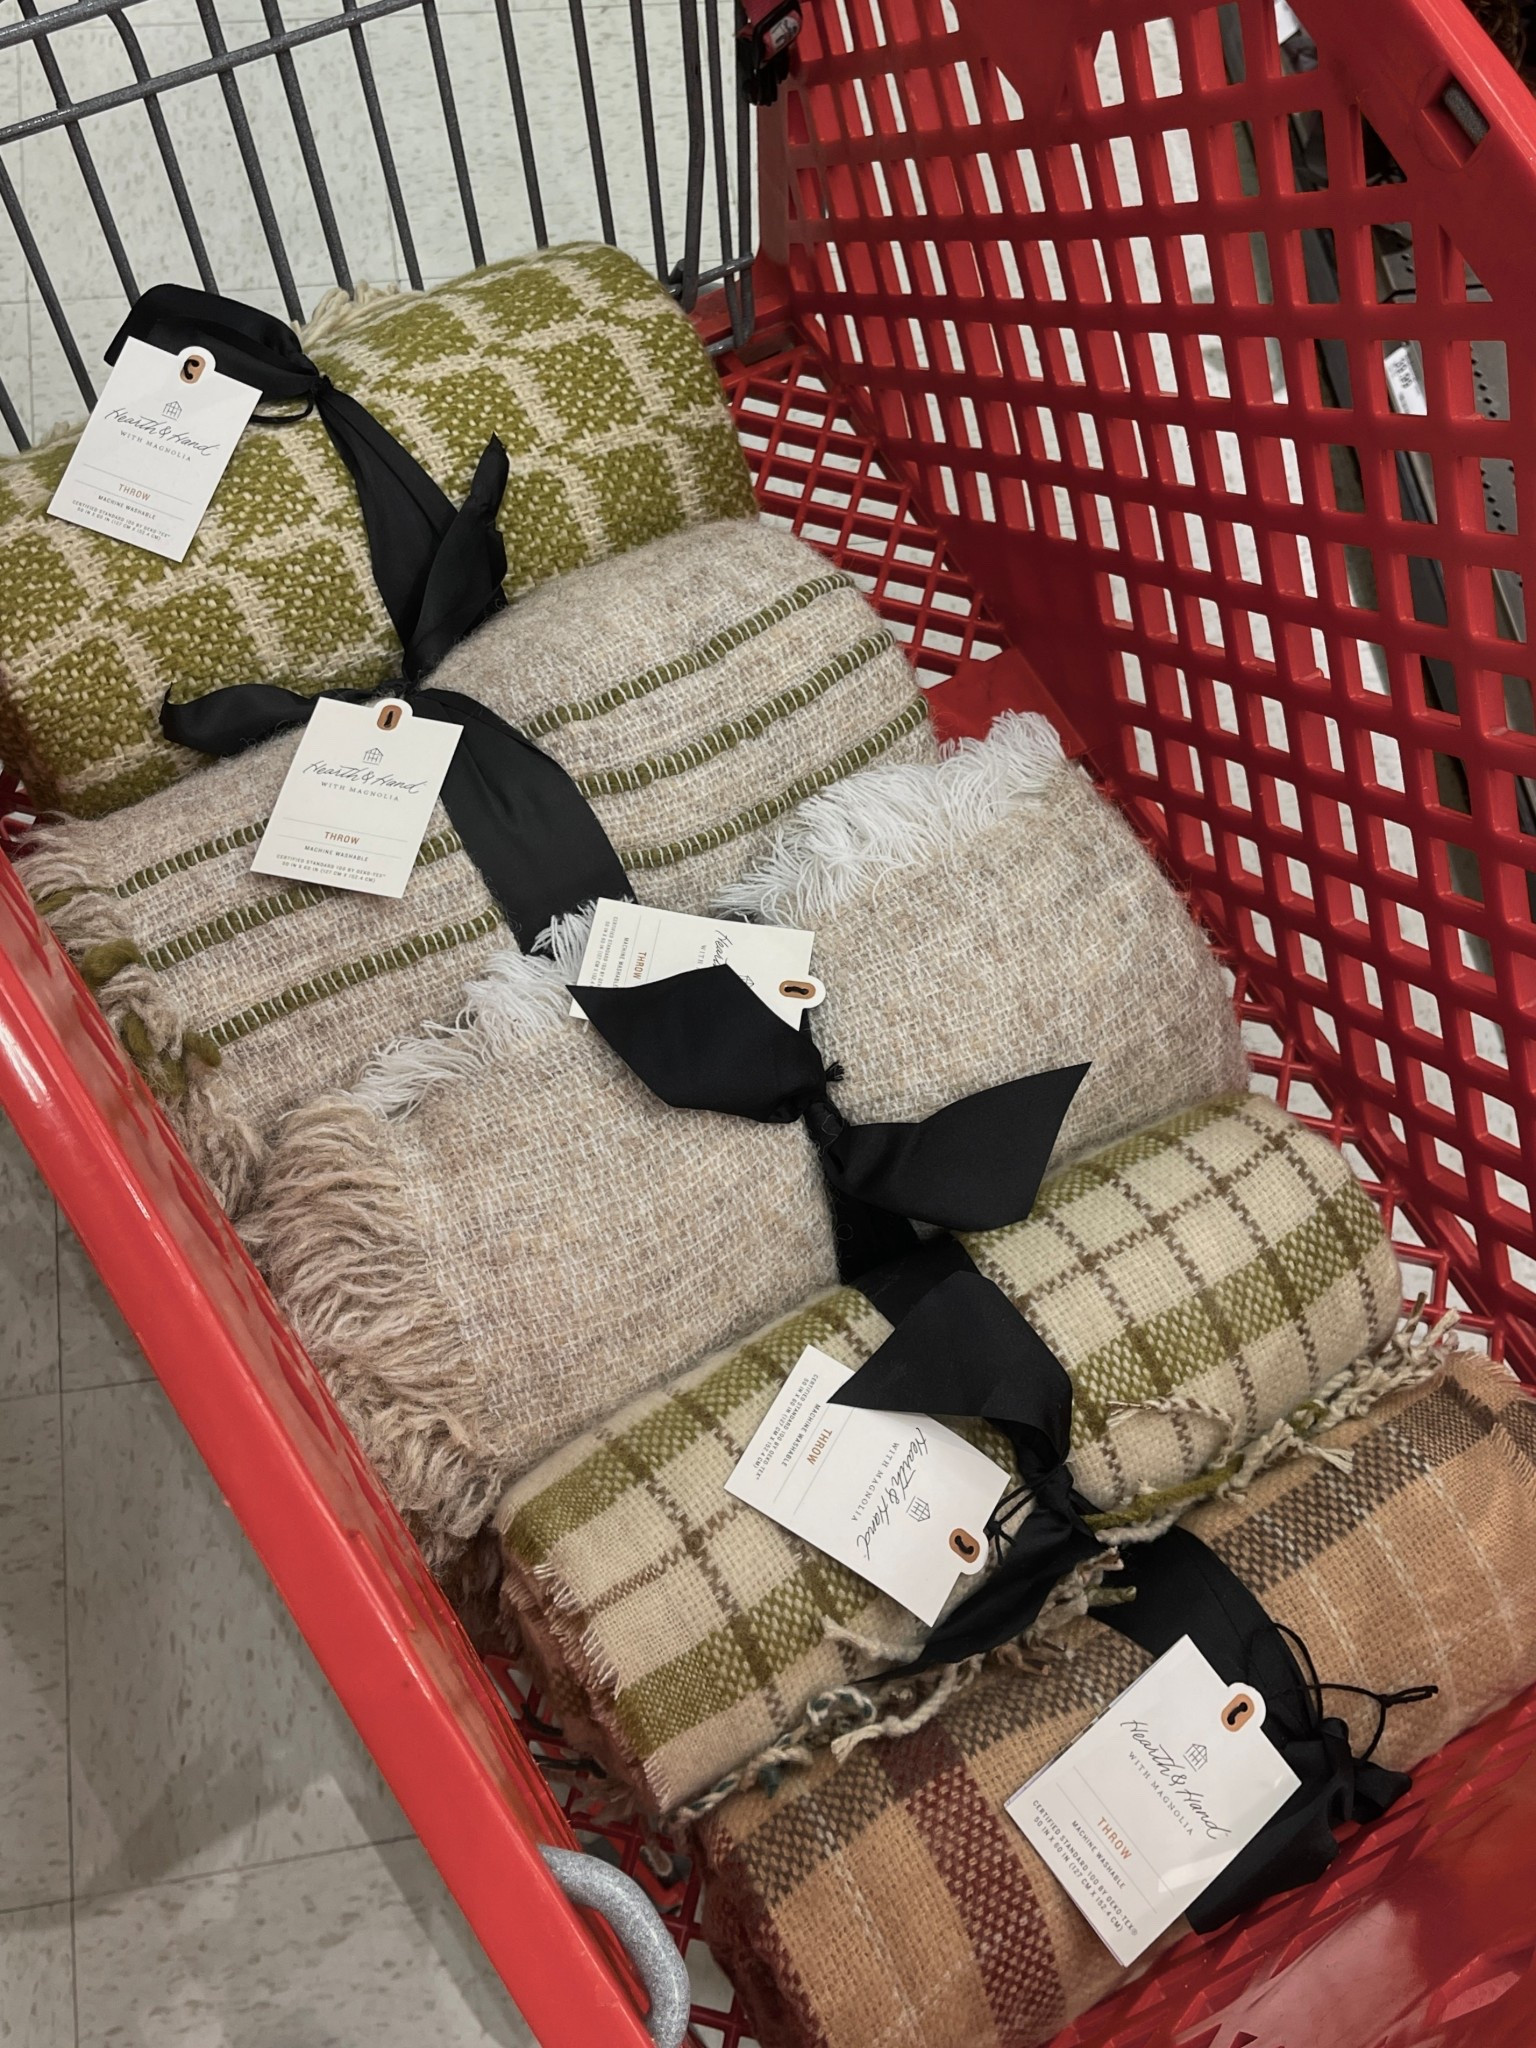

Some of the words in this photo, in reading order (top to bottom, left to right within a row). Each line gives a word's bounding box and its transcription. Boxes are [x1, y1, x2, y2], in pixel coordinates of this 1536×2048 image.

[104, 407, 168, 435] Hearth
[158, 425, 172, 439] &
[165, 431, 221, 457] Hand
[120, 429, 143, 443] WITH
[145, 440, 191, 462] MAGNOLIA
[97, 495, 124, 508] MACHINE
[125, 504, 156, 520] WASHABLE
[118, 483, 151, 502] THROW
[302, 760, 369, 782] Hearth
[361, 770, 375, 785] &
[370, 773, 428, 795] Hand
[321, 781, 346, 791] WITH
[348, 786, 399, 802] MAGNOLIA
[304, 845, 333, 856] MACHINE
[335, 851, 369, 862] WASHABLE
[324, 831, 360, 845] THROW
[618, 937, 630, 960] MACHINE
[697, 944, 707, 965] WITH
[632, 951, 648, 980] THROW
[800, 1403, 822, 1433] MACHINE
[781, 1433, 805, 1467] WASHABLE
[806, 1428, 833, 1466] THROW
[881, 1442, 900, 1468] WITH
[890, 1427, 929, 1501] Hearth
[851, 1469, 884, 1521] MAGNOLIA
[884, 1487, 900, 1505] &
[856, 1495, 890, 1561] Hand
[1119, 1719, 1186, 1777] Hearth
[1128, 1751, 1151, 1780] WITH
[1150, 1780, 1194, 1836] MAGNOLIA
[1168, 1774, 1188, 1787] &
[1174, 1788, 1232, 1840] Hand
[1032, 1799, 1061, 1836] CERTIFIED
[1059, 1834, 1089, 1872] STANDARD
[1097, 1884, 1108, 1896] BY
[1071, 1820, 1098, 1853] MACHINE
[1096, 1851, 1126, 1889] WASHABLE
[1097, 1816, 1133, 1860] THROW
